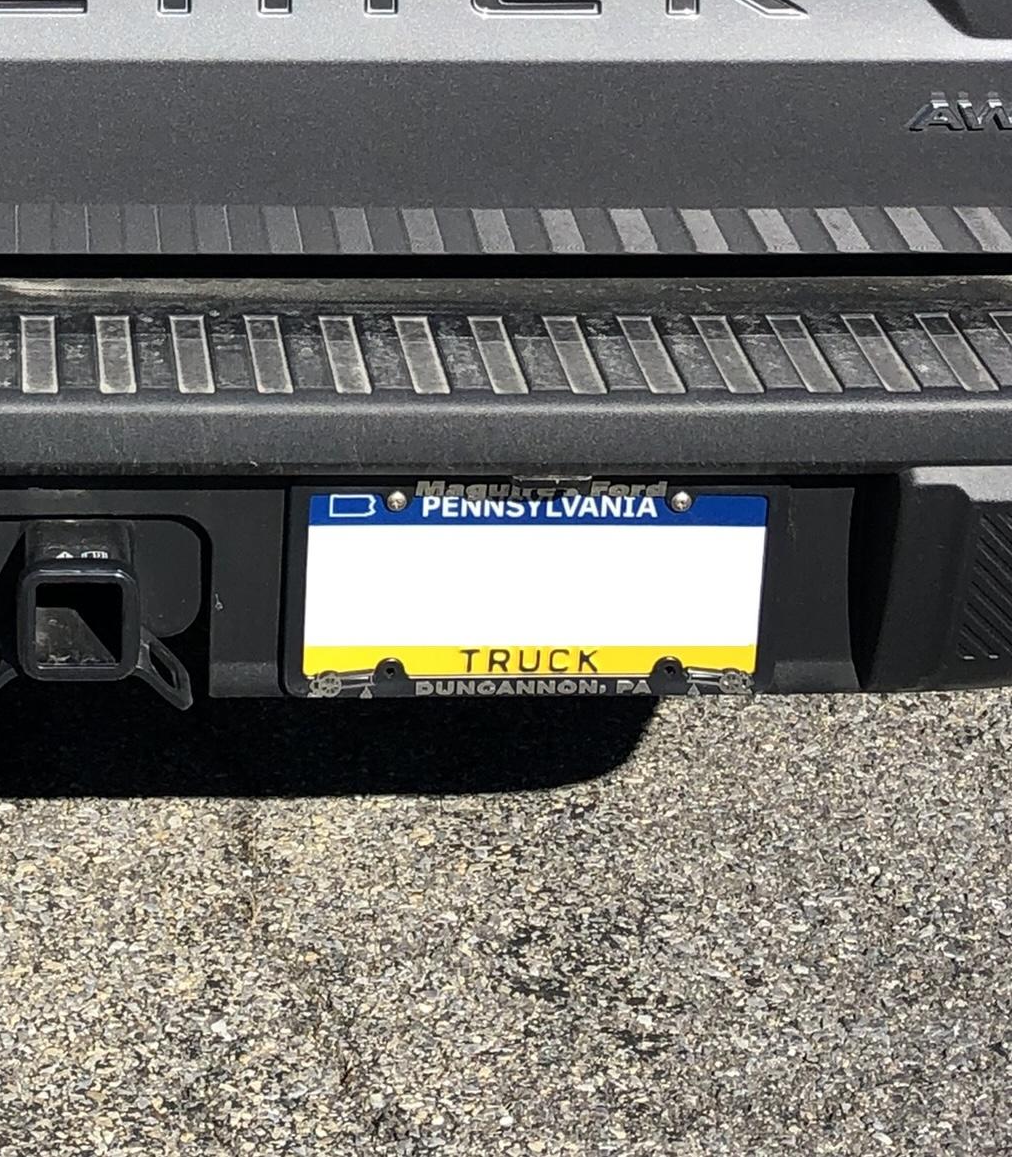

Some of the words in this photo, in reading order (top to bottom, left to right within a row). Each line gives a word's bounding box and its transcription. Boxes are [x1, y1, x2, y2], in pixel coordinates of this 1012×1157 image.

[590, 480, 669, 498] Ford
[421, 495, 659, 518] PENNSYLVANIA
[459, 648, 600, 673] TRUCK
[615, 680, 653, 695] PA
